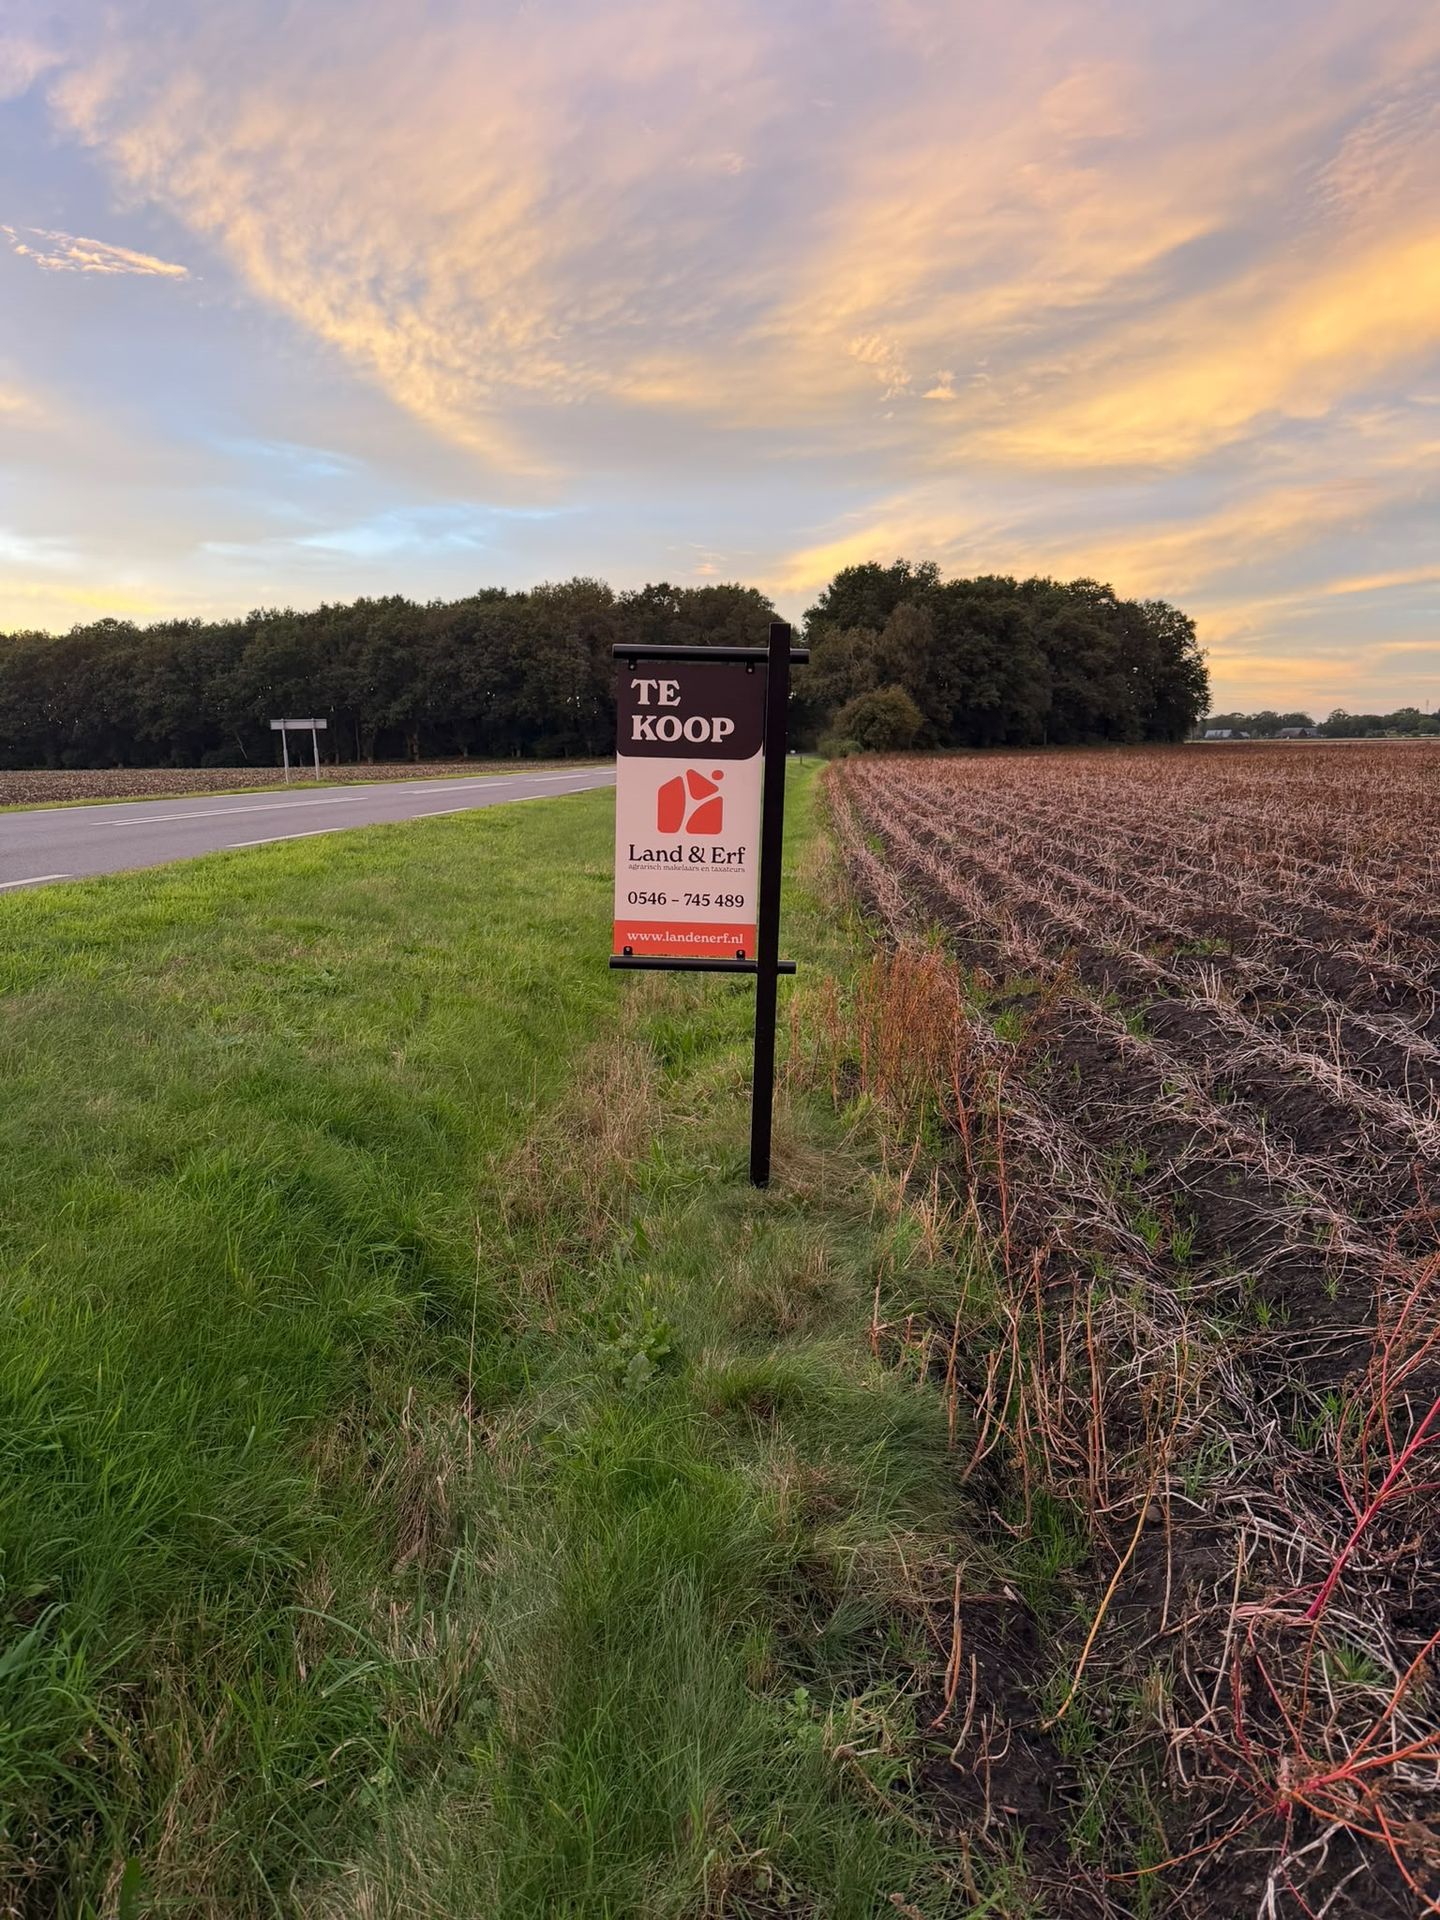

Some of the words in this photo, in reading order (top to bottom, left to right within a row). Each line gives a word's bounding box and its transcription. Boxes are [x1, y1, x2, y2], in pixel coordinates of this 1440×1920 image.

[630, 679, 681, 707] TE
[631, 715, 735, 743] KOOP
[629, 844, 682, 862] Land
[688, 846, 706, 864] &
[711, 847, 746, 865] Erf
[628, 863, 661, 871] agrarisch
[663, 864, 700, 872] makelaars
[711, 865, 745, 873] taxateurs
[627, 891, 667, 905] 0546
[683, 893, 711, 907] 745
[714, 894, 745, 908] 489
[627, 931, 743, 944] www.landenerf.nl
